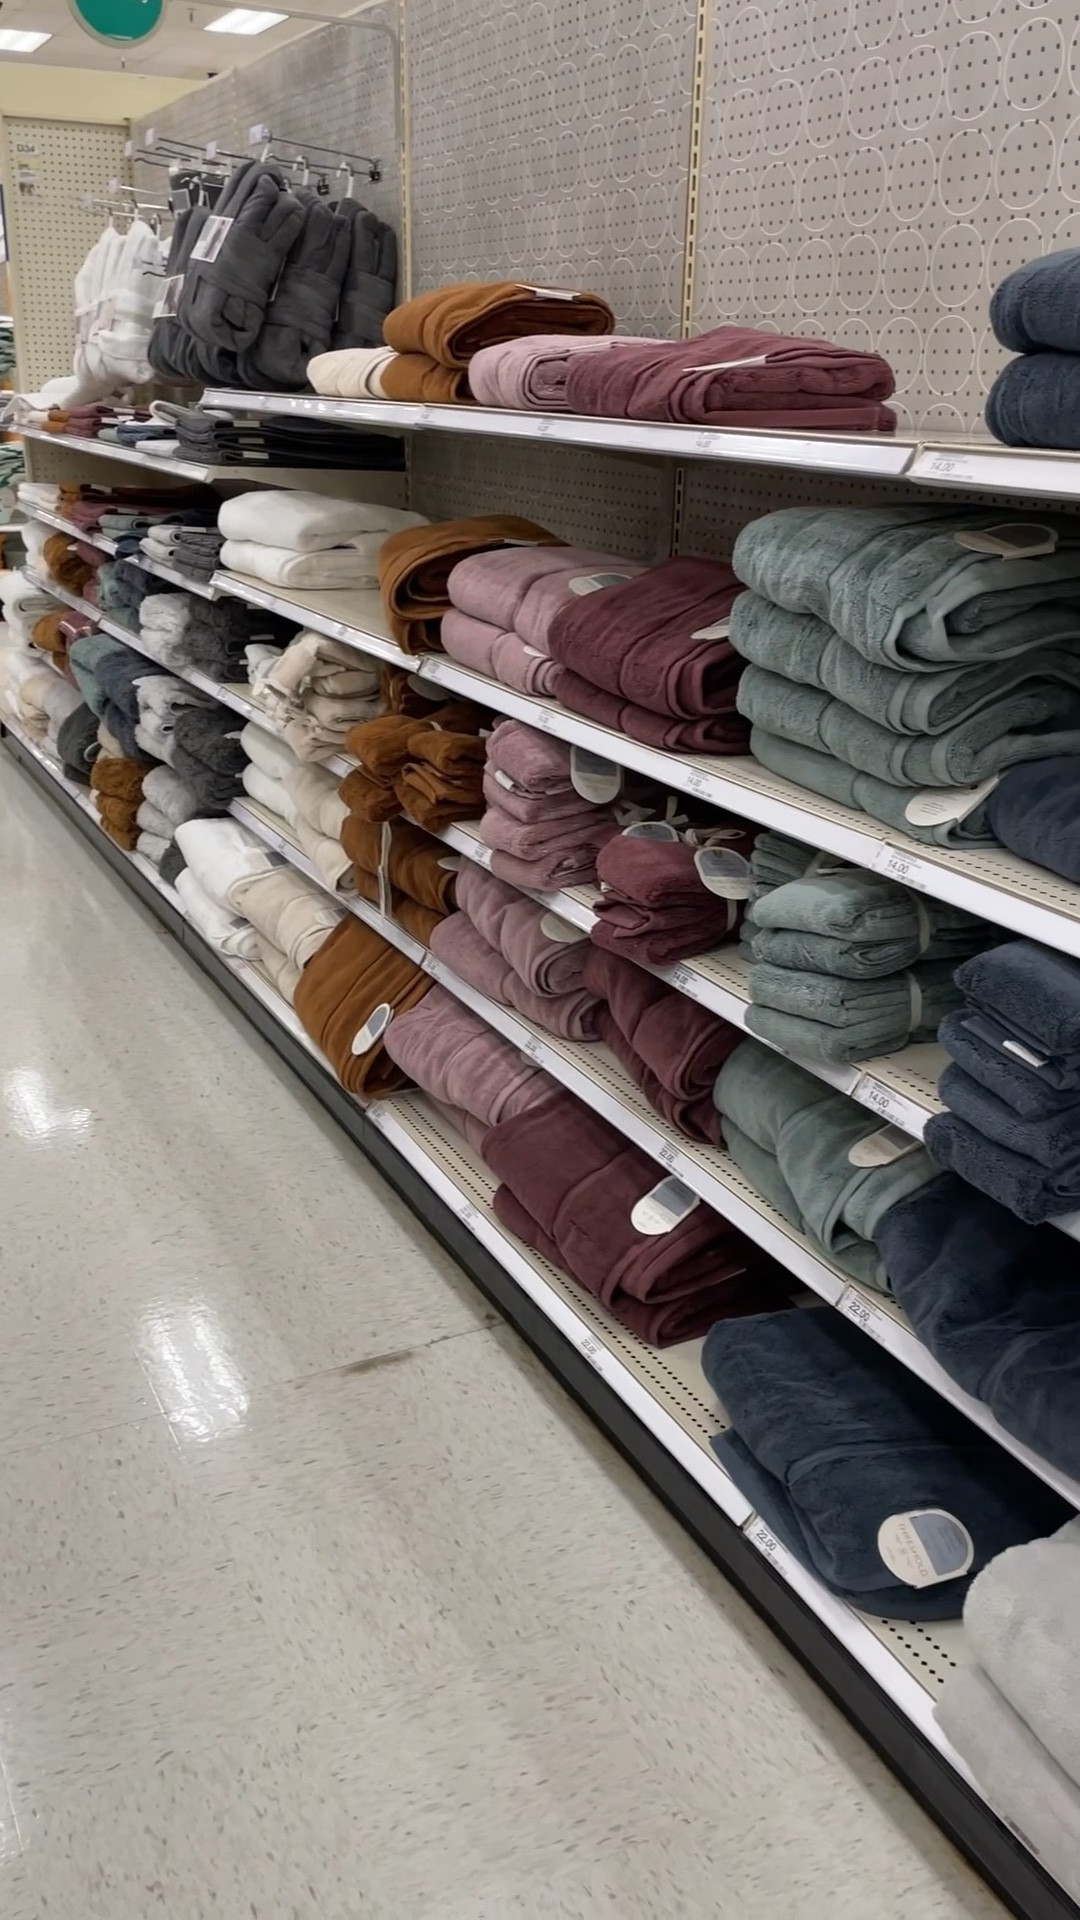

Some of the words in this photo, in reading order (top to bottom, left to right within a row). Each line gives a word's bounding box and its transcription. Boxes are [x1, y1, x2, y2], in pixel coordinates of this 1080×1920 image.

[887, 859, 910, 875] 14.00
[868, 1090, 890, 1109] 14.00
[848, 1301, 871, 1322] 22.00
[755, 1529, 777, 1552] 22.00
[897, 1523, 929, 1577] THRESHOLD
